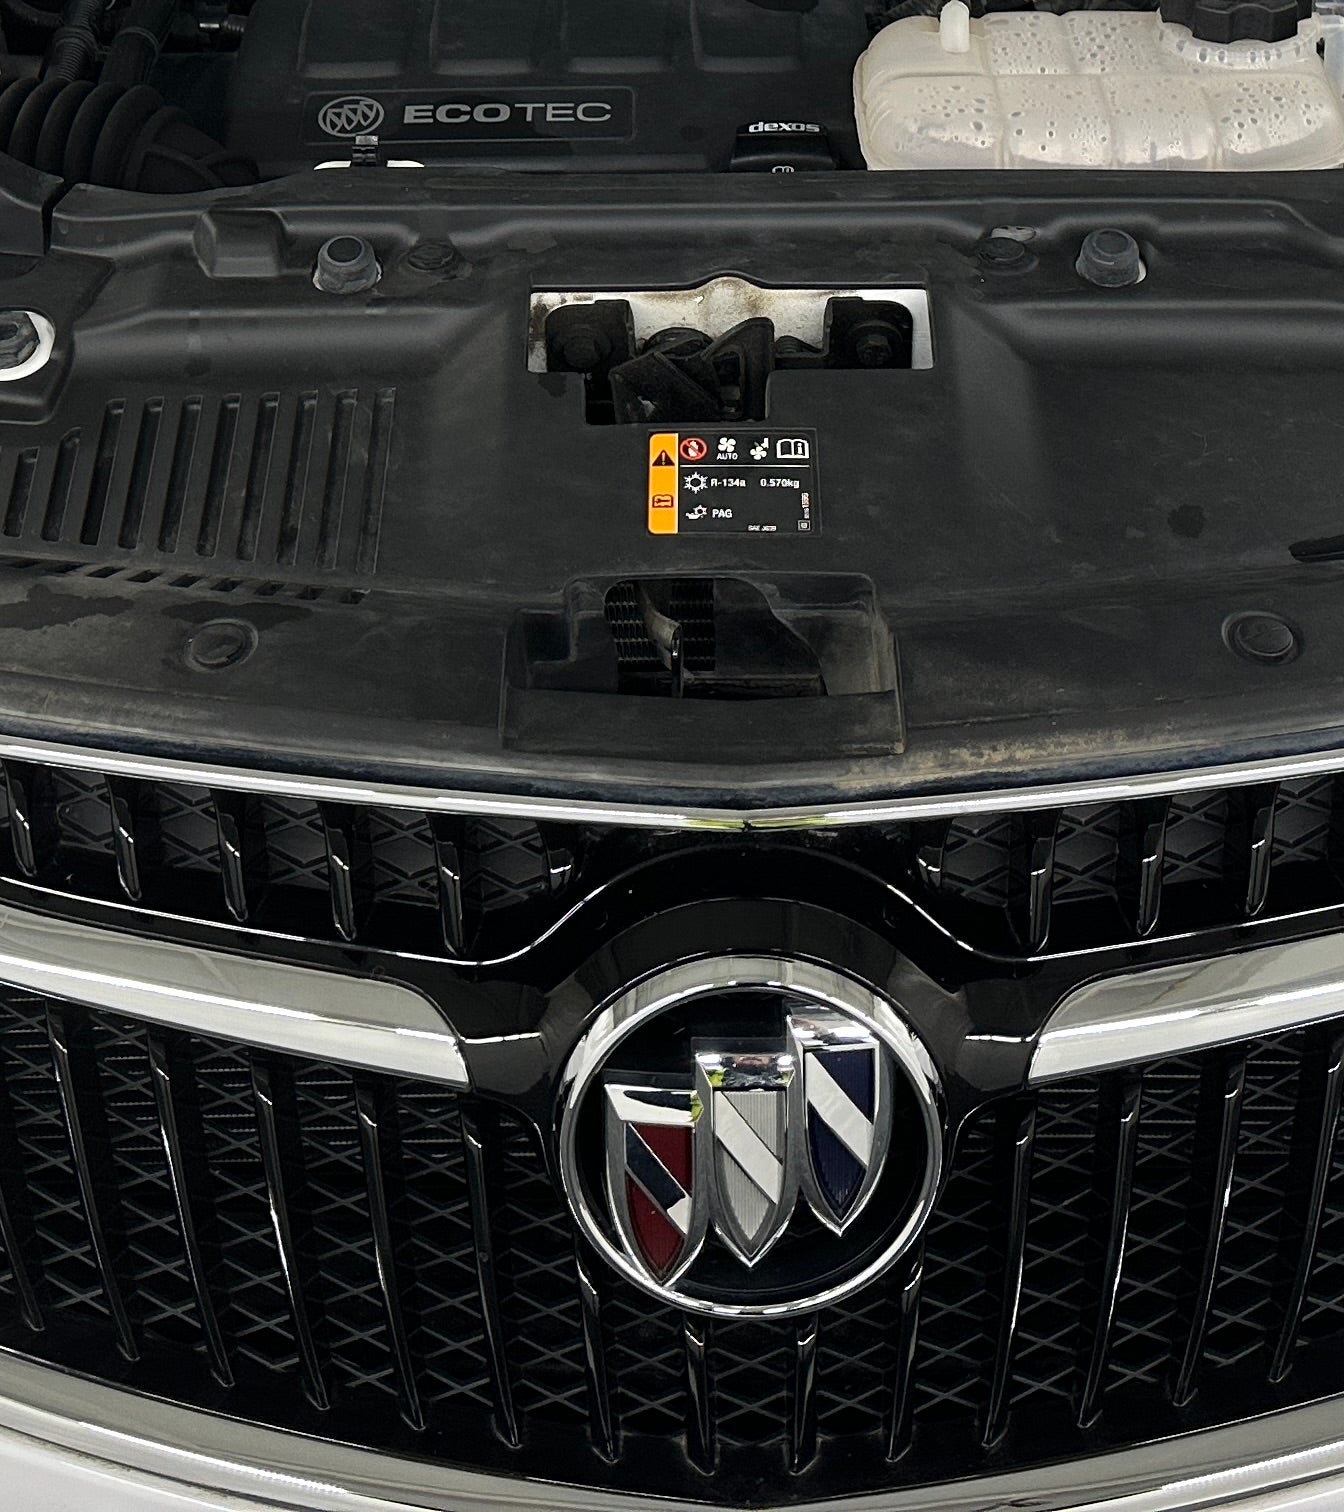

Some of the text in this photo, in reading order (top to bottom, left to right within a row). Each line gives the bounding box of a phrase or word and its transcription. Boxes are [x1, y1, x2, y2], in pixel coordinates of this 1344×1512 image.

[403, 103, 612, 124] ECOTEC
[748, 121, 820, 133] dexos
[710, 478, 746, 487] R-134a
[712, 509, 733, 518] PAG
